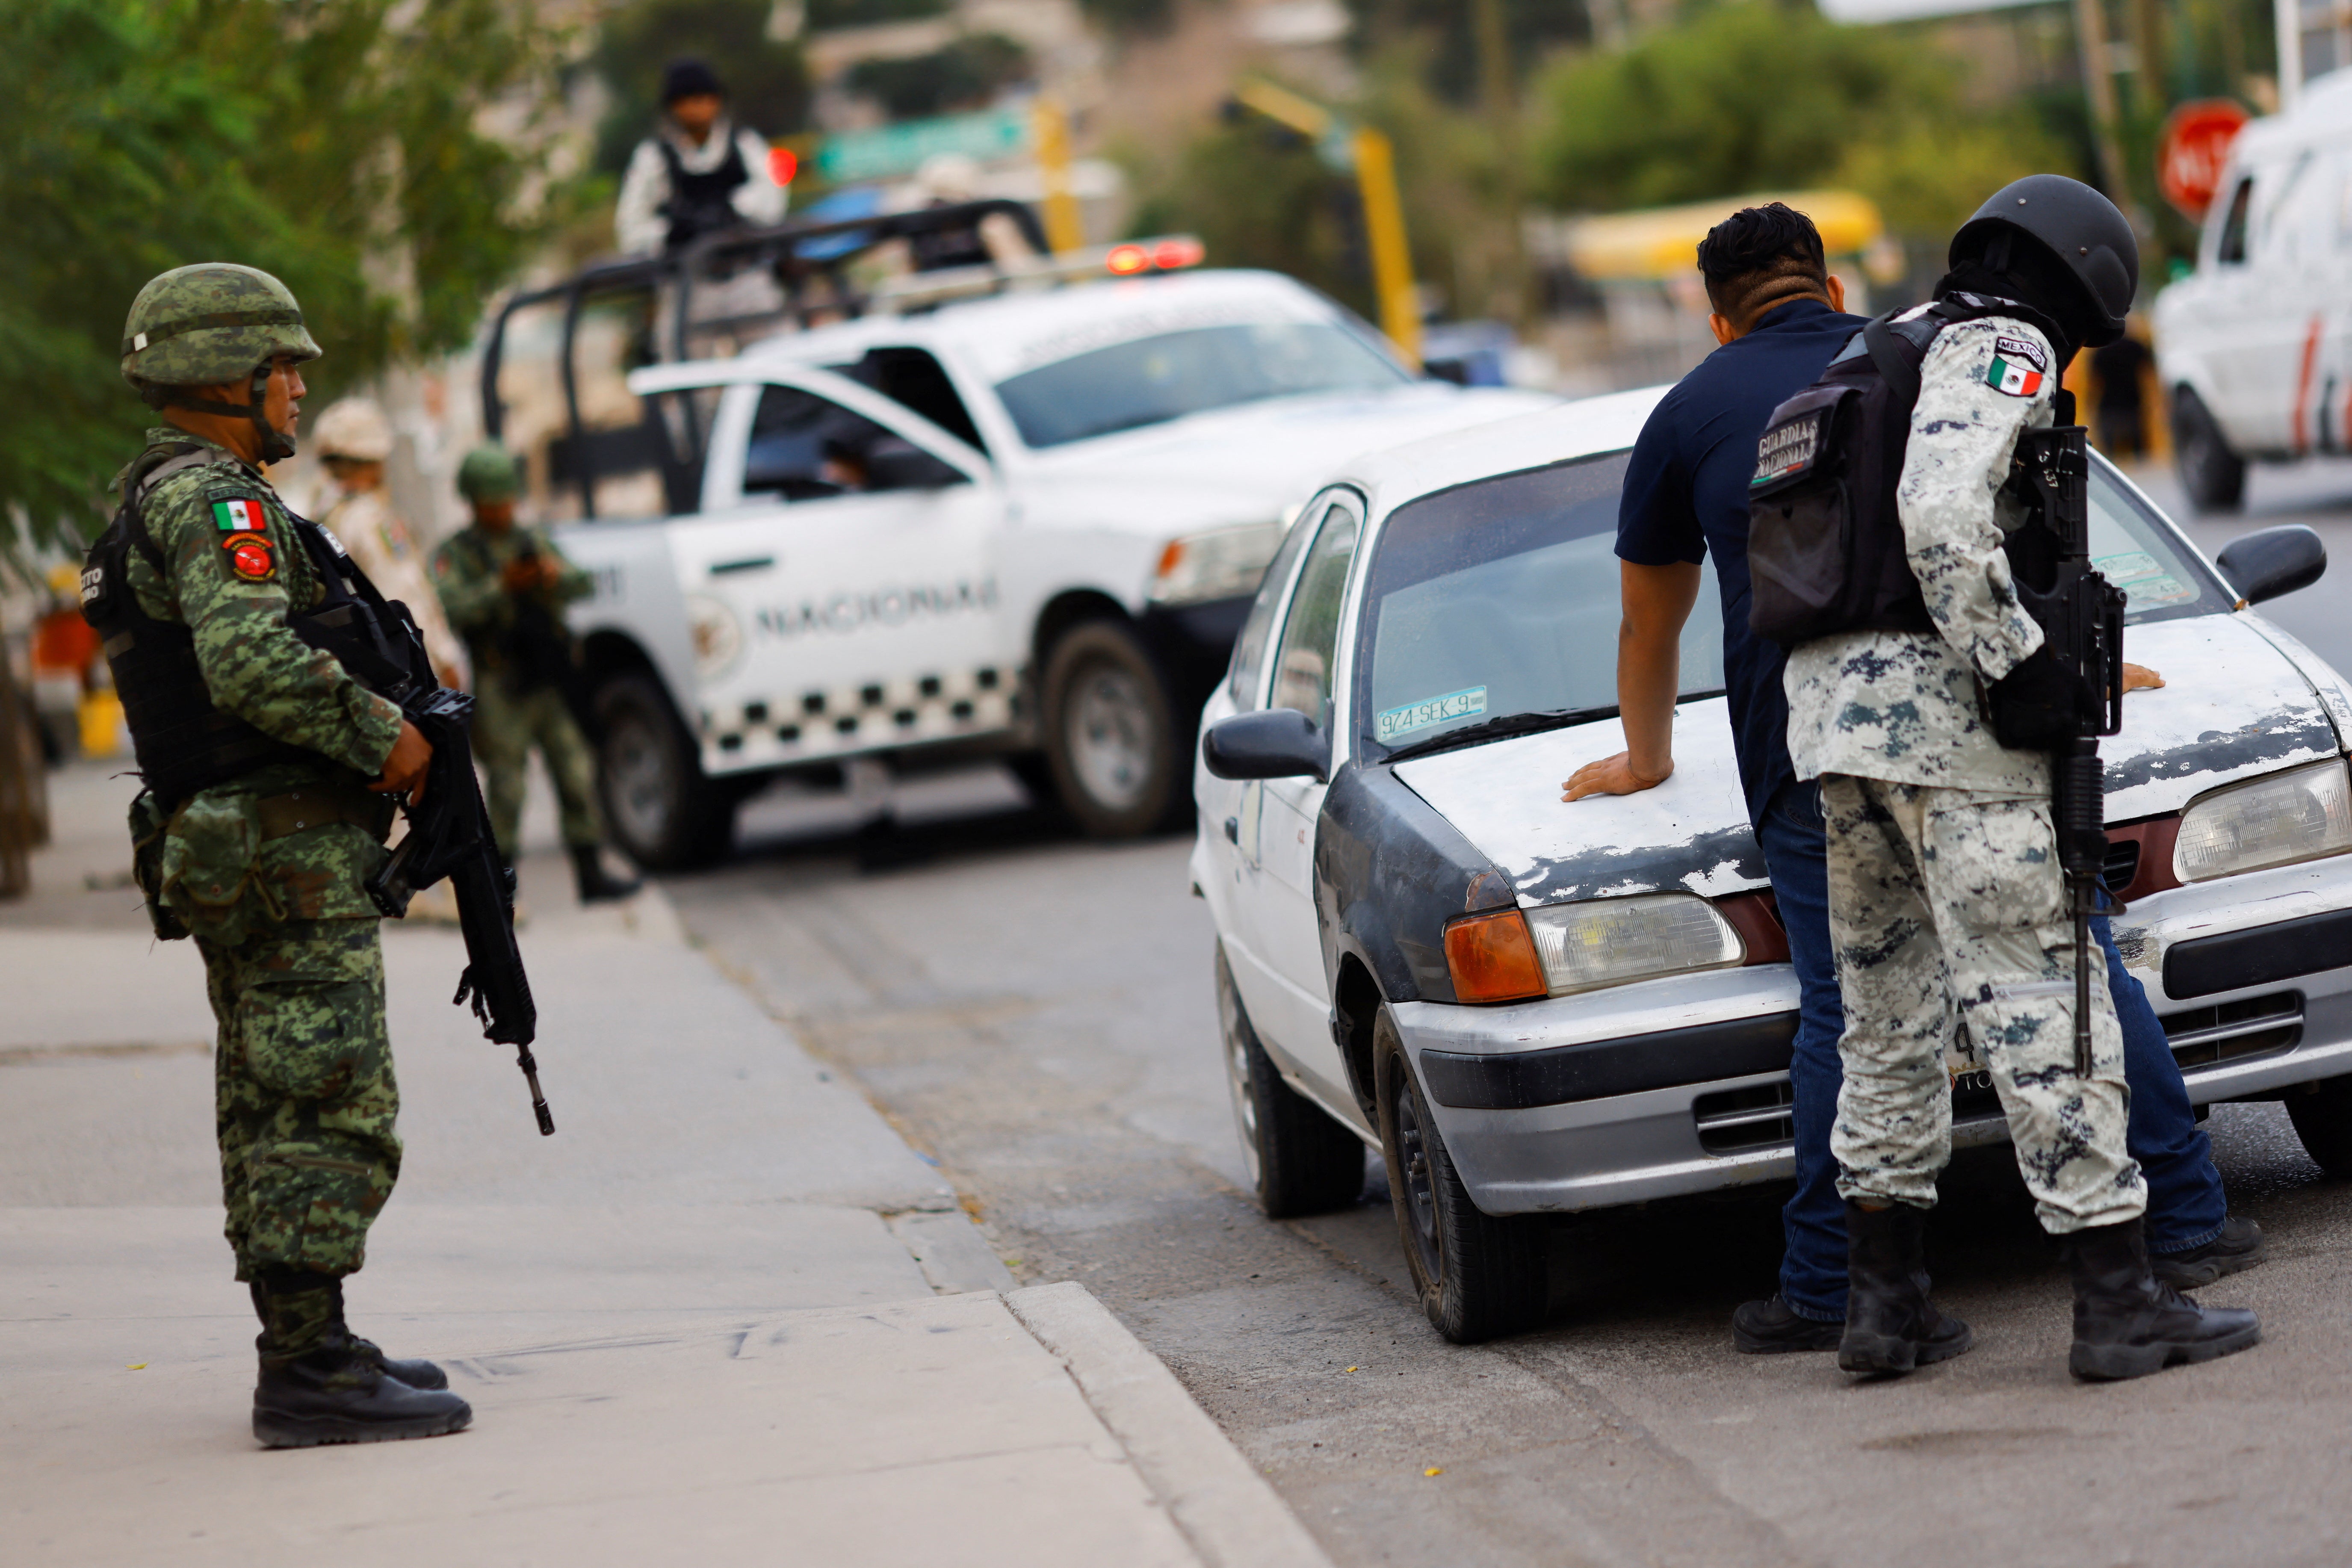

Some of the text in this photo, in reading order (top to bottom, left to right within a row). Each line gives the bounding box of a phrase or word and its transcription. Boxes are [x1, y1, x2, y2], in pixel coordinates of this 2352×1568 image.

[2000, 340, 2042, 364] MEXICO
[1758, 421, 1808, 458] GUARDIA
[1753, 444, 1809, 478] NACIONAL
[1949, 1070, 1993, 1091] TO
